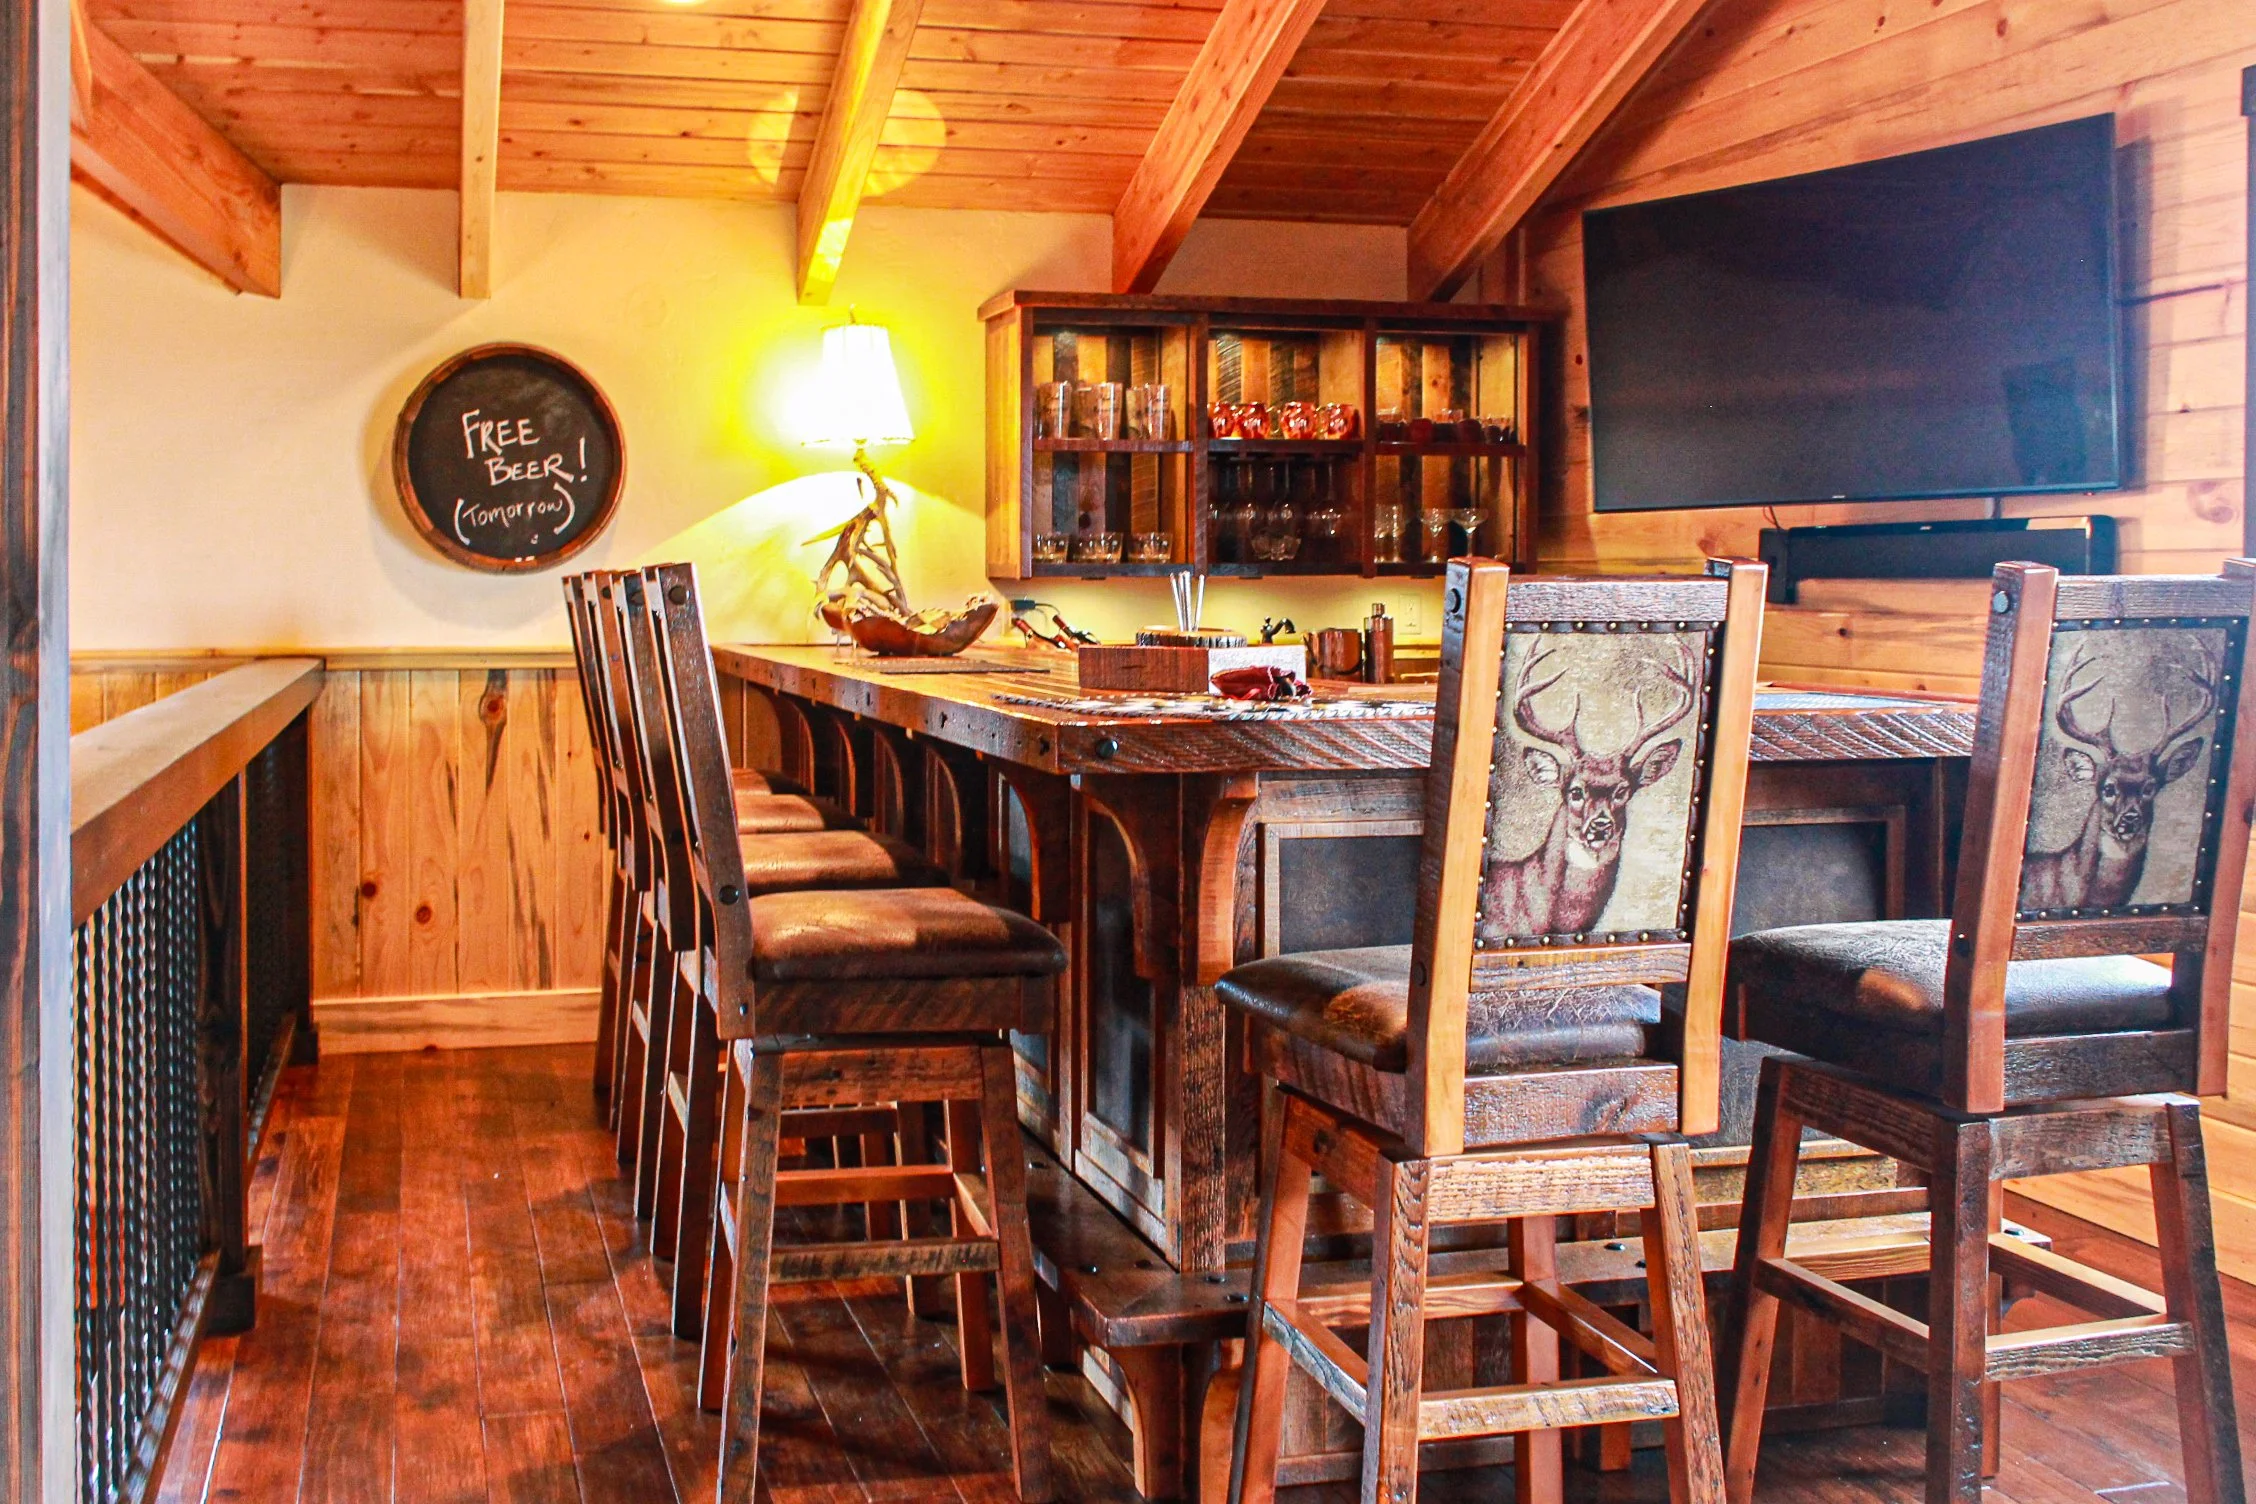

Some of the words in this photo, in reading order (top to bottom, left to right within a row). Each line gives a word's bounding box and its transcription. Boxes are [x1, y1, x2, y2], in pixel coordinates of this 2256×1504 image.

[462, 409, 540, 459] FREE
[484, 437, 587, 486] BEER!
[454, 482, 575, 545] (Tomorrow)
